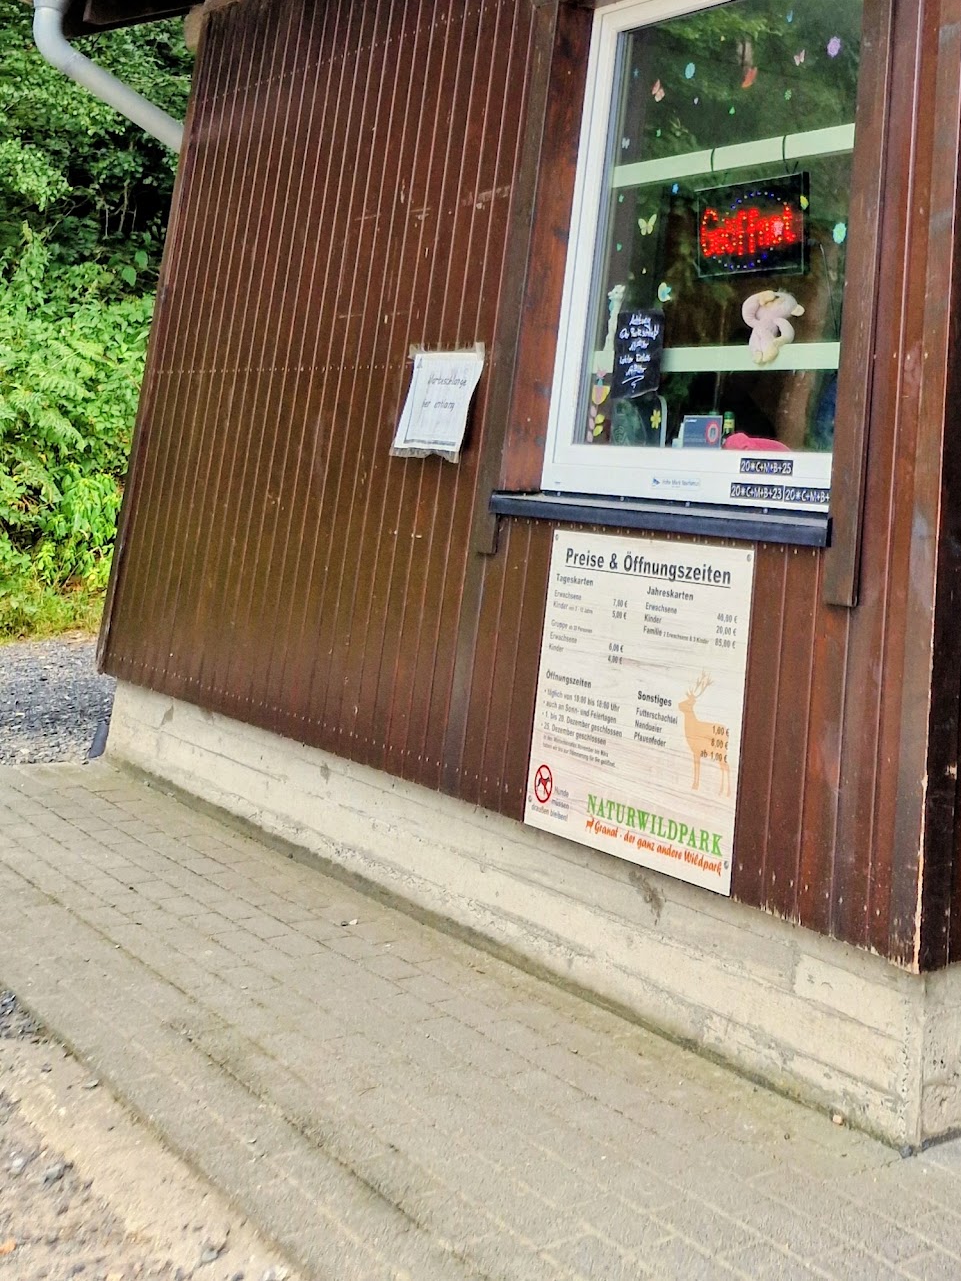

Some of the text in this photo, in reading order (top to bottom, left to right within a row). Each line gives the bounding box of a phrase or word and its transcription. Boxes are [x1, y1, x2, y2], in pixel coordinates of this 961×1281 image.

[565, 547, 731, 584] Preise & Öffnungszeiten
[556, 573, 594, 586] Tageskarten
[646, 586, 694, 601] Jahreskarten
[645, 602, 677, 614] Erwachsene
[644, 613, 662, 624] Kinder
[546, 669, 592, 688] Öffnungszeiten
[637, 690, 672, 707] Sonstiges
[636, 707, 678, 725] Futterschachtel
[586, 793, 723, 857] NATURWILDPARK
[594, 819, 722, 877] Granat der ganz andere Wildpark
